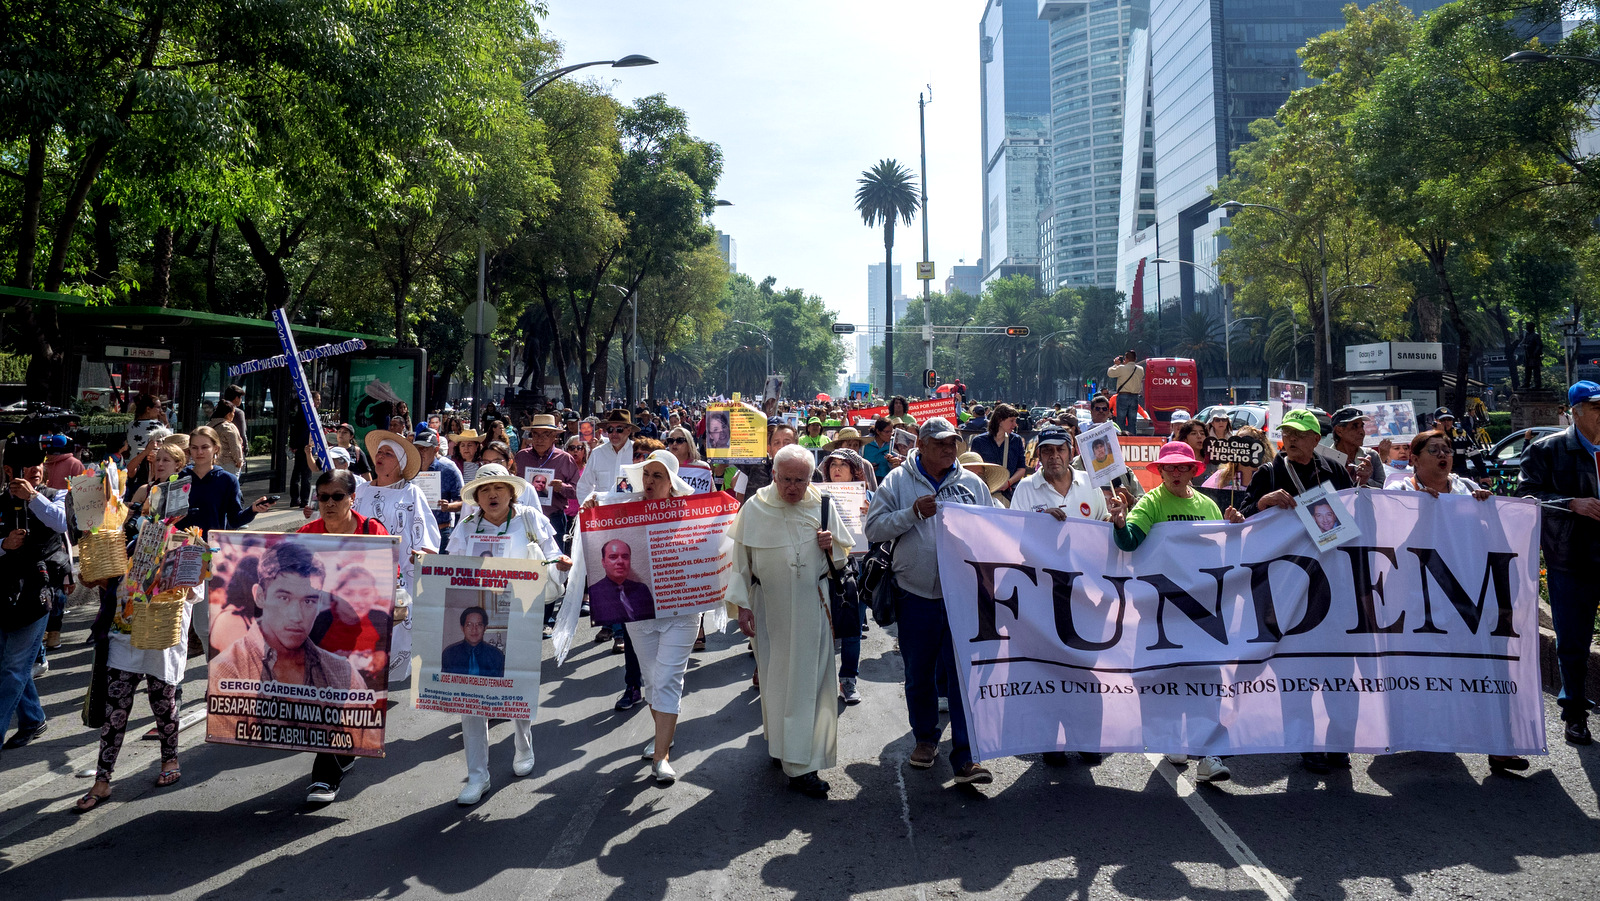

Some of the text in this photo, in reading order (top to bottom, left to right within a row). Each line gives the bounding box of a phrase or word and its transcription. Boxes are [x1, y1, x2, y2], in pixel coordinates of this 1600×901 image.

[229, 365, 240, 376] NO
[241, 362, 256, 374] MAS
[300, 352, 310, 360] NI
[272, 311, 292, 357] BASTA
[292, 367, 323, 452] JUSTICIA
[1207, 446, 1250, 455] Hubieras
[1210, 452, 1250, 463] Hecho
[585, 502, 740, 529] SEÑOR GOBERNADOR DE NUEVO LEÓ
[645, 499, 687, 513] ¡YA BASTA
[422, 566, 538, 580] MI HIJO FUE DESAPARECIDO
[652, 560, 686, 569] DESAPARECIÓ
[451, 577, 480, 586] DONDE
[964, 546, 1520, 652] FUNDEM
[451, 675, 468, 685] ANTONIO
[469, 676, 488, 686] ROBLEDO
[980, 676, 1517, 700] FUERZAS UNIDAS POR NUESTROS DESAPARECIDOS EN MÉXICO
[220, 681, 374, 701] SERGIO CÁRDENAS CÓRDOBA
[210, 697, 382, 726] DESAPARECIÓ EN NAVA COAHUILA
[237, 724, 352, 748] EL 22 DE ABRIL DEL 2009
